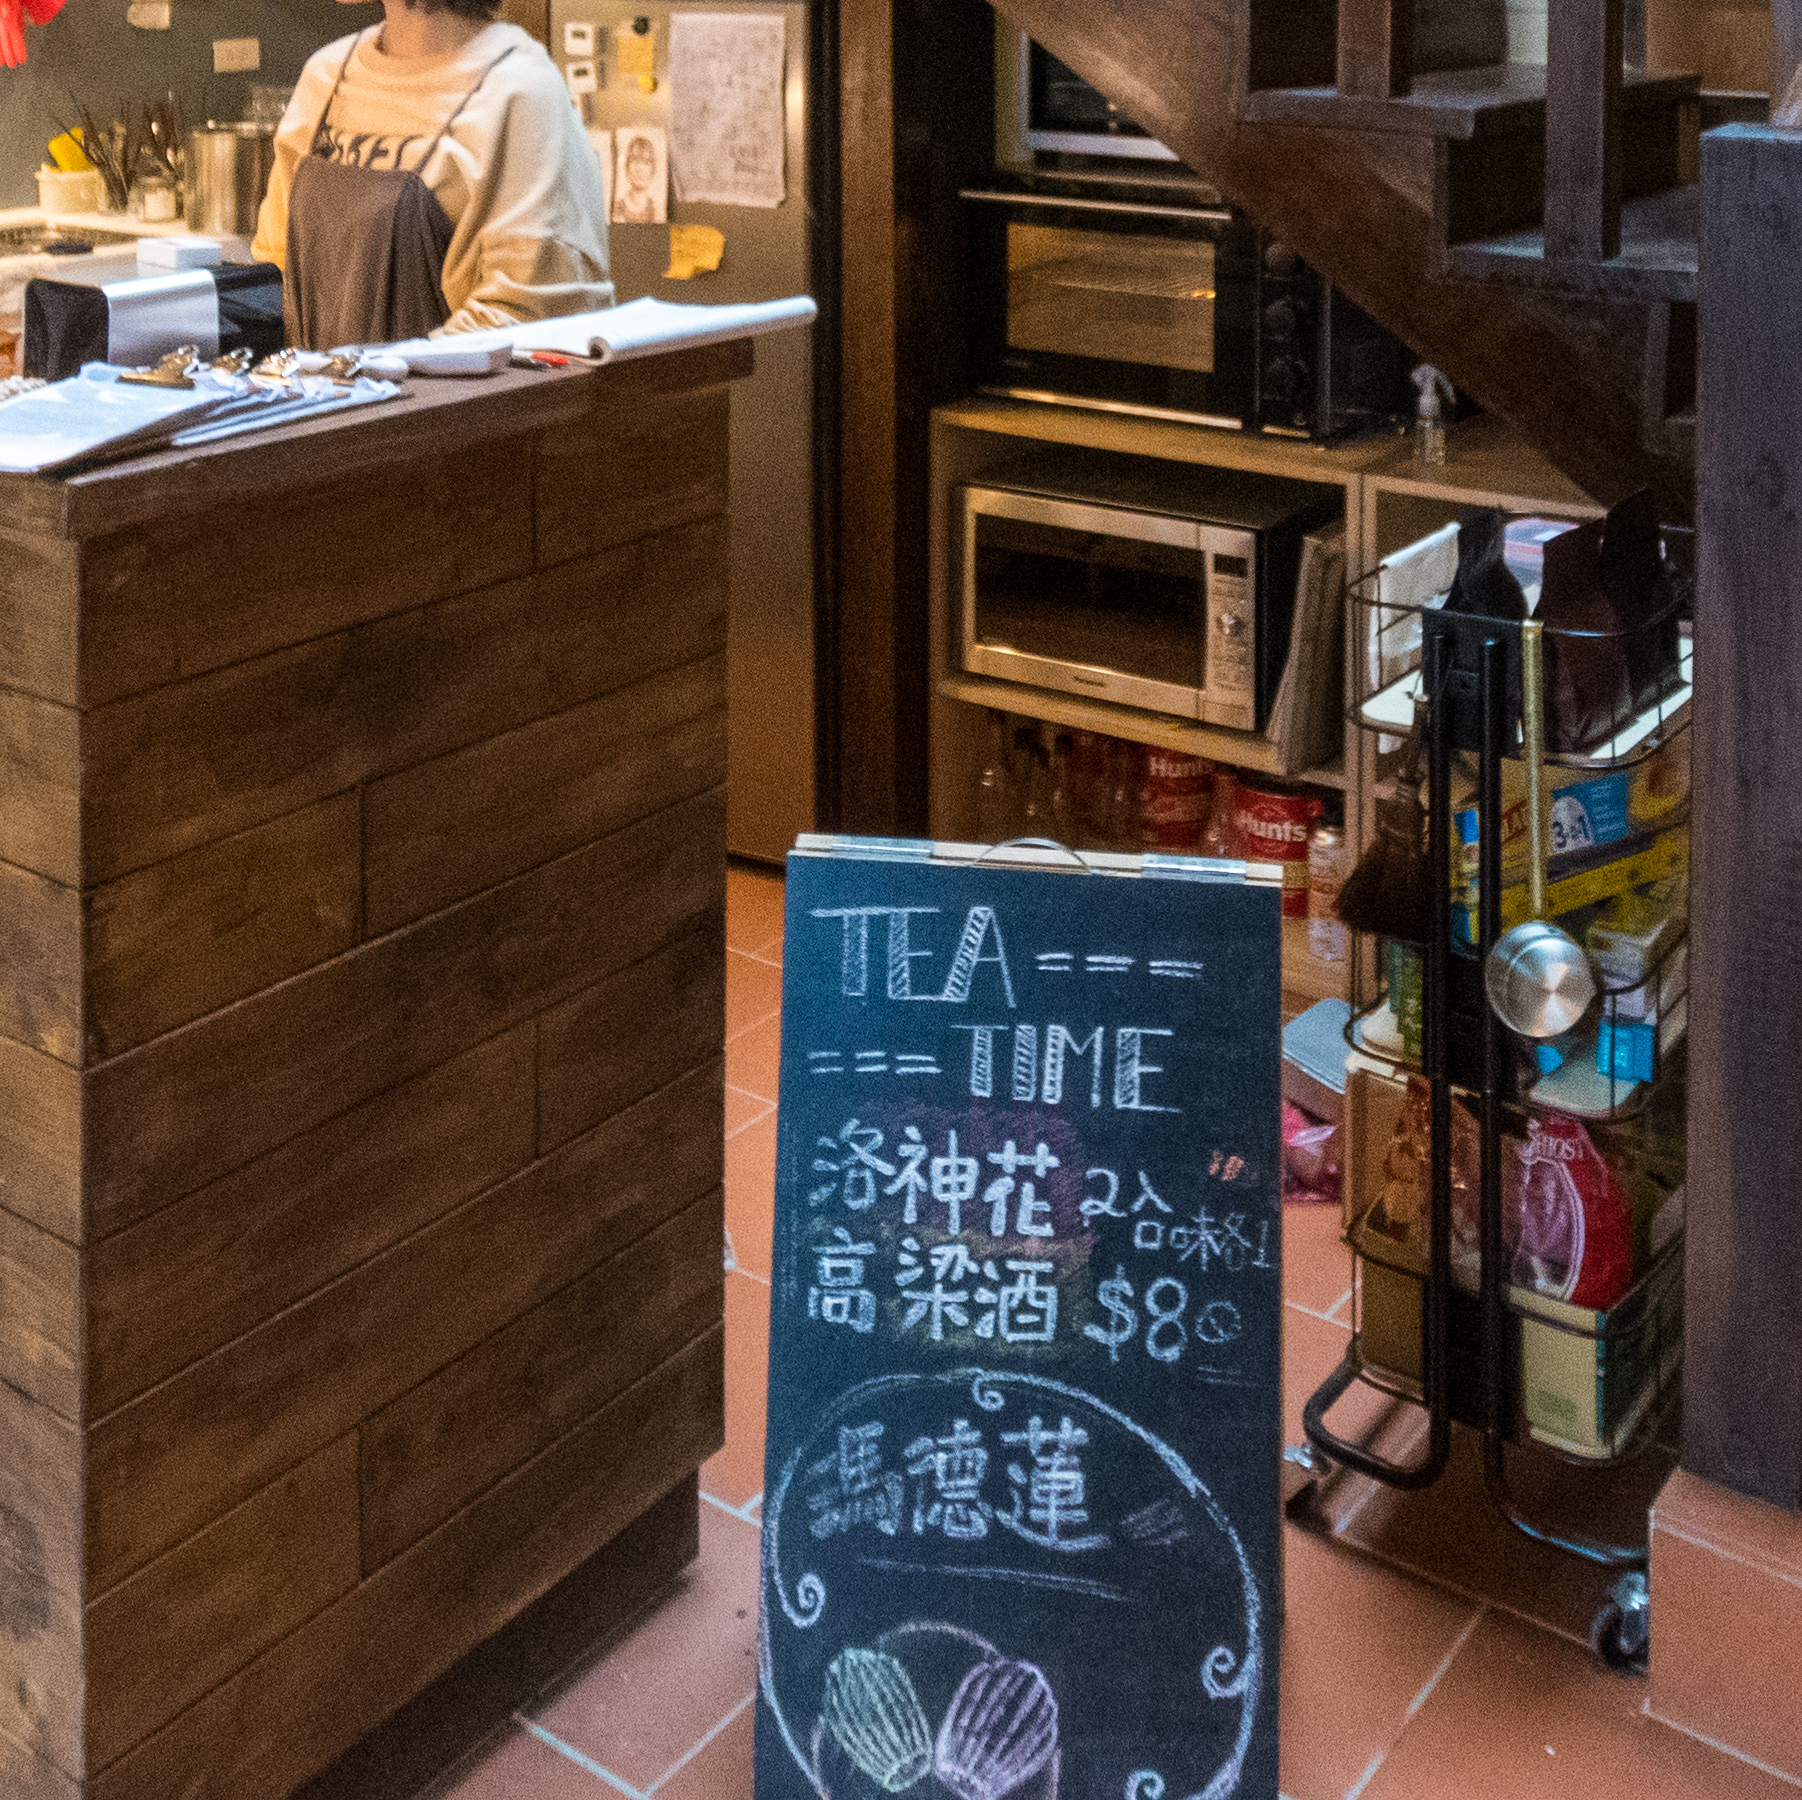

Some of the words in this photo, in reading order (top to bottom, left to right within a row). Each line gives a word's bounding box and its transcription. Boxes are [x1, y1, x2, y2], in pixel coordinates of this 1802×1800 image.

[809, 905, 1017, 1009] TEA
[949, 1022, 1183, 1114] TIME
[808, 1117, 1061, 1239] 洛神花
[806, 1414, 1111, 1552] 瑪德蓮
